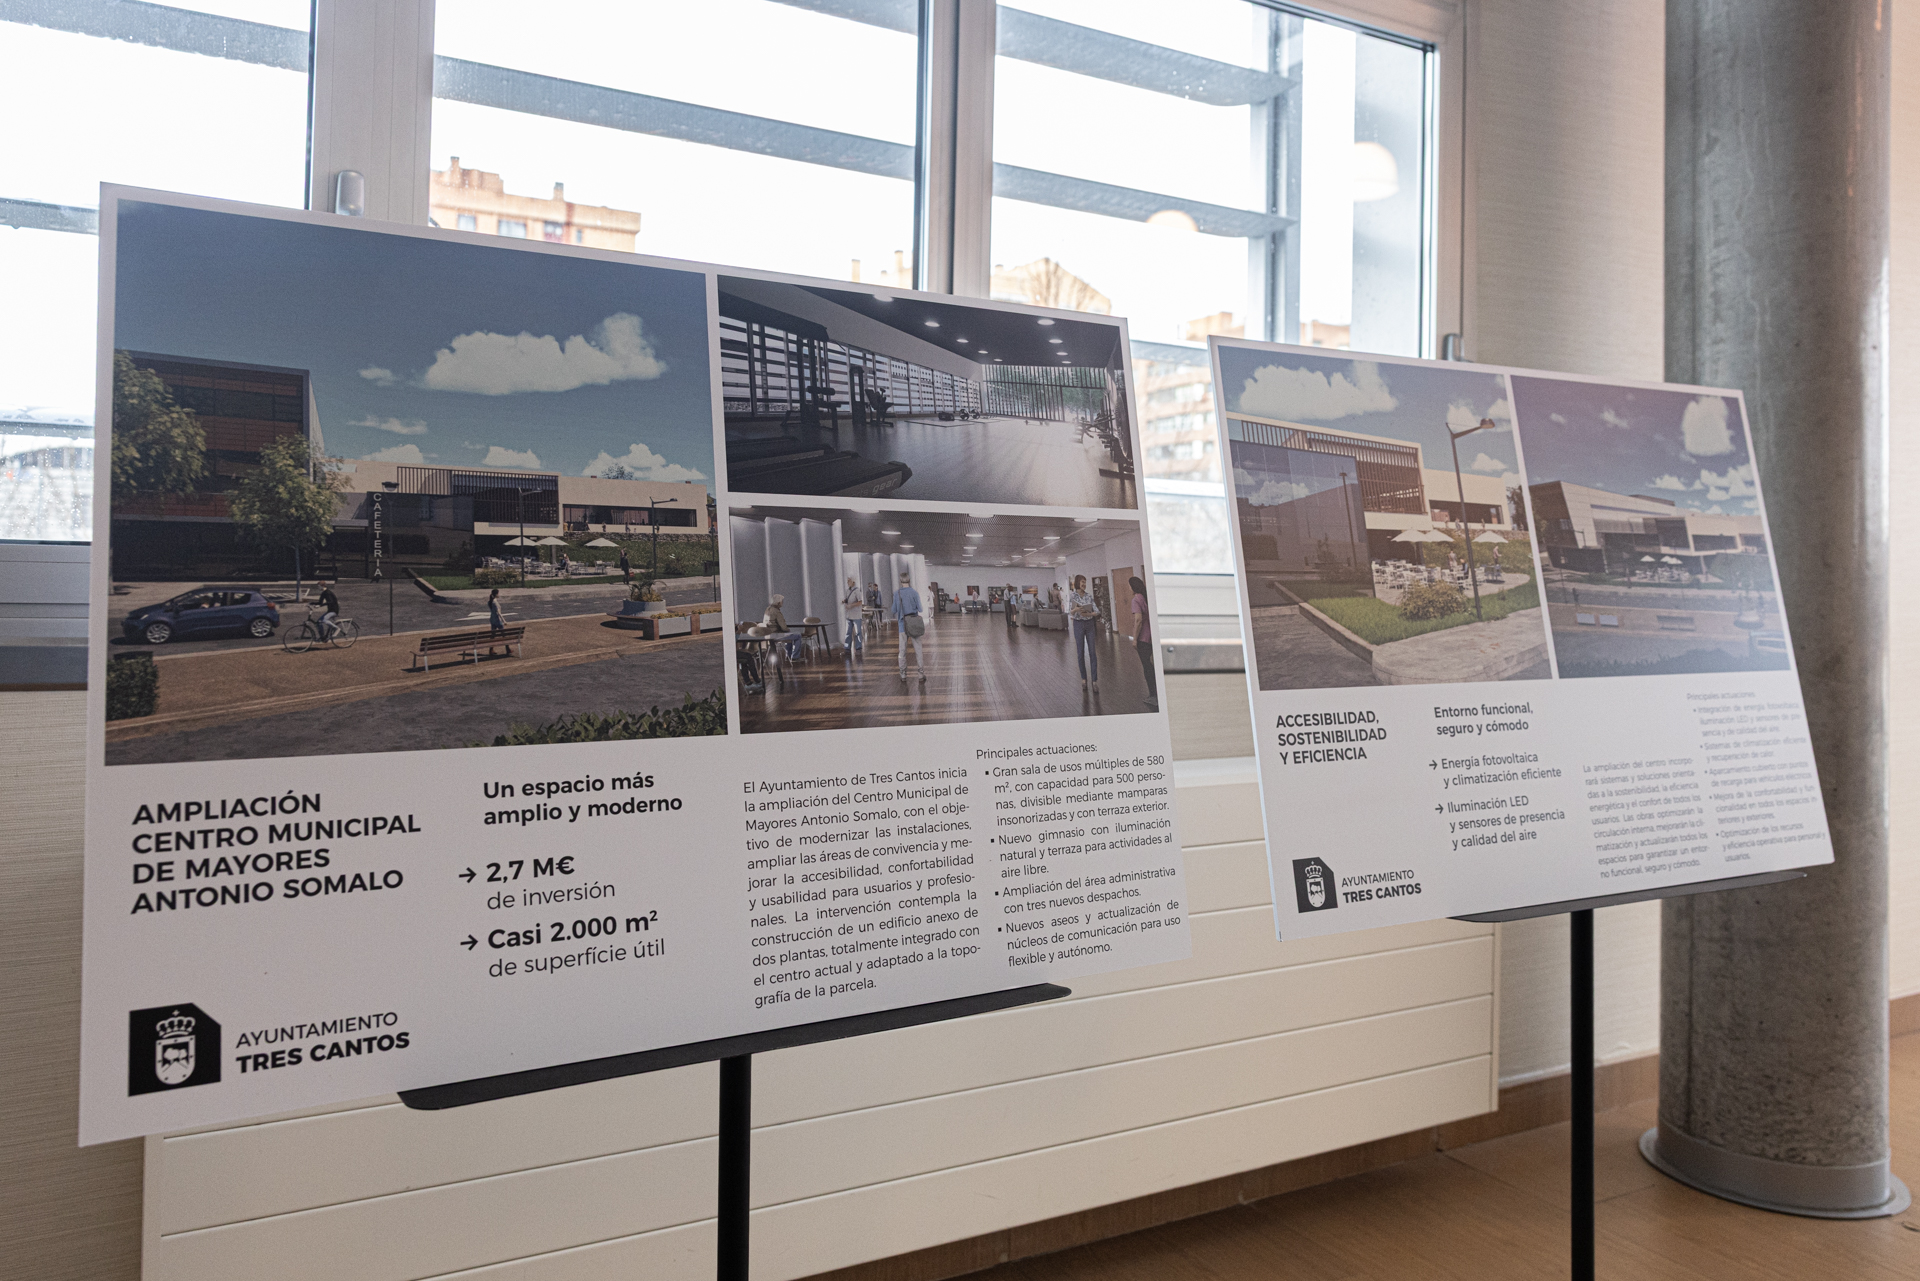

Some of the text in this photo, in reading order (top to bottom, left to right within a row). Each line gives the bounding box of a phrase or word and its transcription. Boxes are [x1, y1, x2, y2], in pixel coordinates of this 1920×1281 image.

[373, 493, 383, 577] CAFETERIA
[1276, 710, 1379, 728] ACCESIBILIDAD,
[1433, 702, 1533, 718] Entorno funcional,
[1277, 727, 1387, 746] SOSTENIBILIDAD
[1436, 718, 1529, 737] seguro y cómodo
[976, 743, 1097, 760] Principales actuaciones:
[1279, 746, 1367, 765] Y EFICIENCIA
[1441, 752, 1538, 770] Energía fotovoltaica
[992, 755, 1164, 777] Gran sala de usos múltiples de 580
[1443, 767, 1561, 789] y climatización eficiente
[484, 771, 654, 799] Un espacio más
[743, 766, 967, 795] El Ayuntamiento de Tres Cantos inicia
[1014, 782, 1034, 792] con
[1036, 775, 1089, 792] capacidad
[1092, 776, 1114, 788] para
[1116, 772, 1135, 784] 500
[1137, 772, 1165, 784] perso-
[132, 790, 320, 825] AMPLIACIÓN
[483, 796, 682, 827] amplio y moderno
[744, 784, 969, 812] la ampliación del Centro Municipal de
[995, 787, 1168, 810] nas, divisible mediante mamparas
[1447, 795, 1529, 813] Iluminación LED
[745, 801, 969, 833] Mayores Antonio Somalo, con el obje-
[996, 800, 1169, 826] insonorizadas y con terraza exterior.
[1449, 808, 1565, 834] y sensores de presencia
[132, 814, 421, 854] CENTRO MUNICIPAL
[746, 821, 972, 851] tivo de modernizar las instalaciones,
[998, 818, 1171, 845] Nuevo gimnasio con iluminación
[1451, 829, 1537, 851] y calidad del aire
[133, 848, 330, 884] DE MAYORES
[486, 855, 575, 883] 2,7 M€
[747, 853, 974, 892] jorar la accesibilidad, confortabilidad
[1001, 864, 1049, 878] aire libre.
[1341, 869, 1414, 887] AYUNTAMIENTO
[131, 869, 403, 914] ANTONIO SOMALO
[487, 881, 615, 910] de inversión
[1002, 866, 1176, 898] Ampliación del área administrativa
[1342, 882, 1422, 903] TRES CANTOS
[1003, 887, 1141, 914] con tres nuevos despachos.
[487, 910, 658, 949] Casi 2.000 m²
[751, 907, 978, 947] construcción de un edificio anexo de
[1005, 899, 1179, 933] Nuevos aseos y actualización de
[1007, 916, 1181, 950] núcleos de comunicación para uso
[489, 938, 664, 977] de superfície útil
[1008, 943, 1112, 967] flexible y autónomo.
[754, 977, 877, 1009] grafía de la parcela.
[236, 1011, 398, 1049] AYUNTAMIENTO
[235, 1031, 410, 1073] TRES CANTOS
